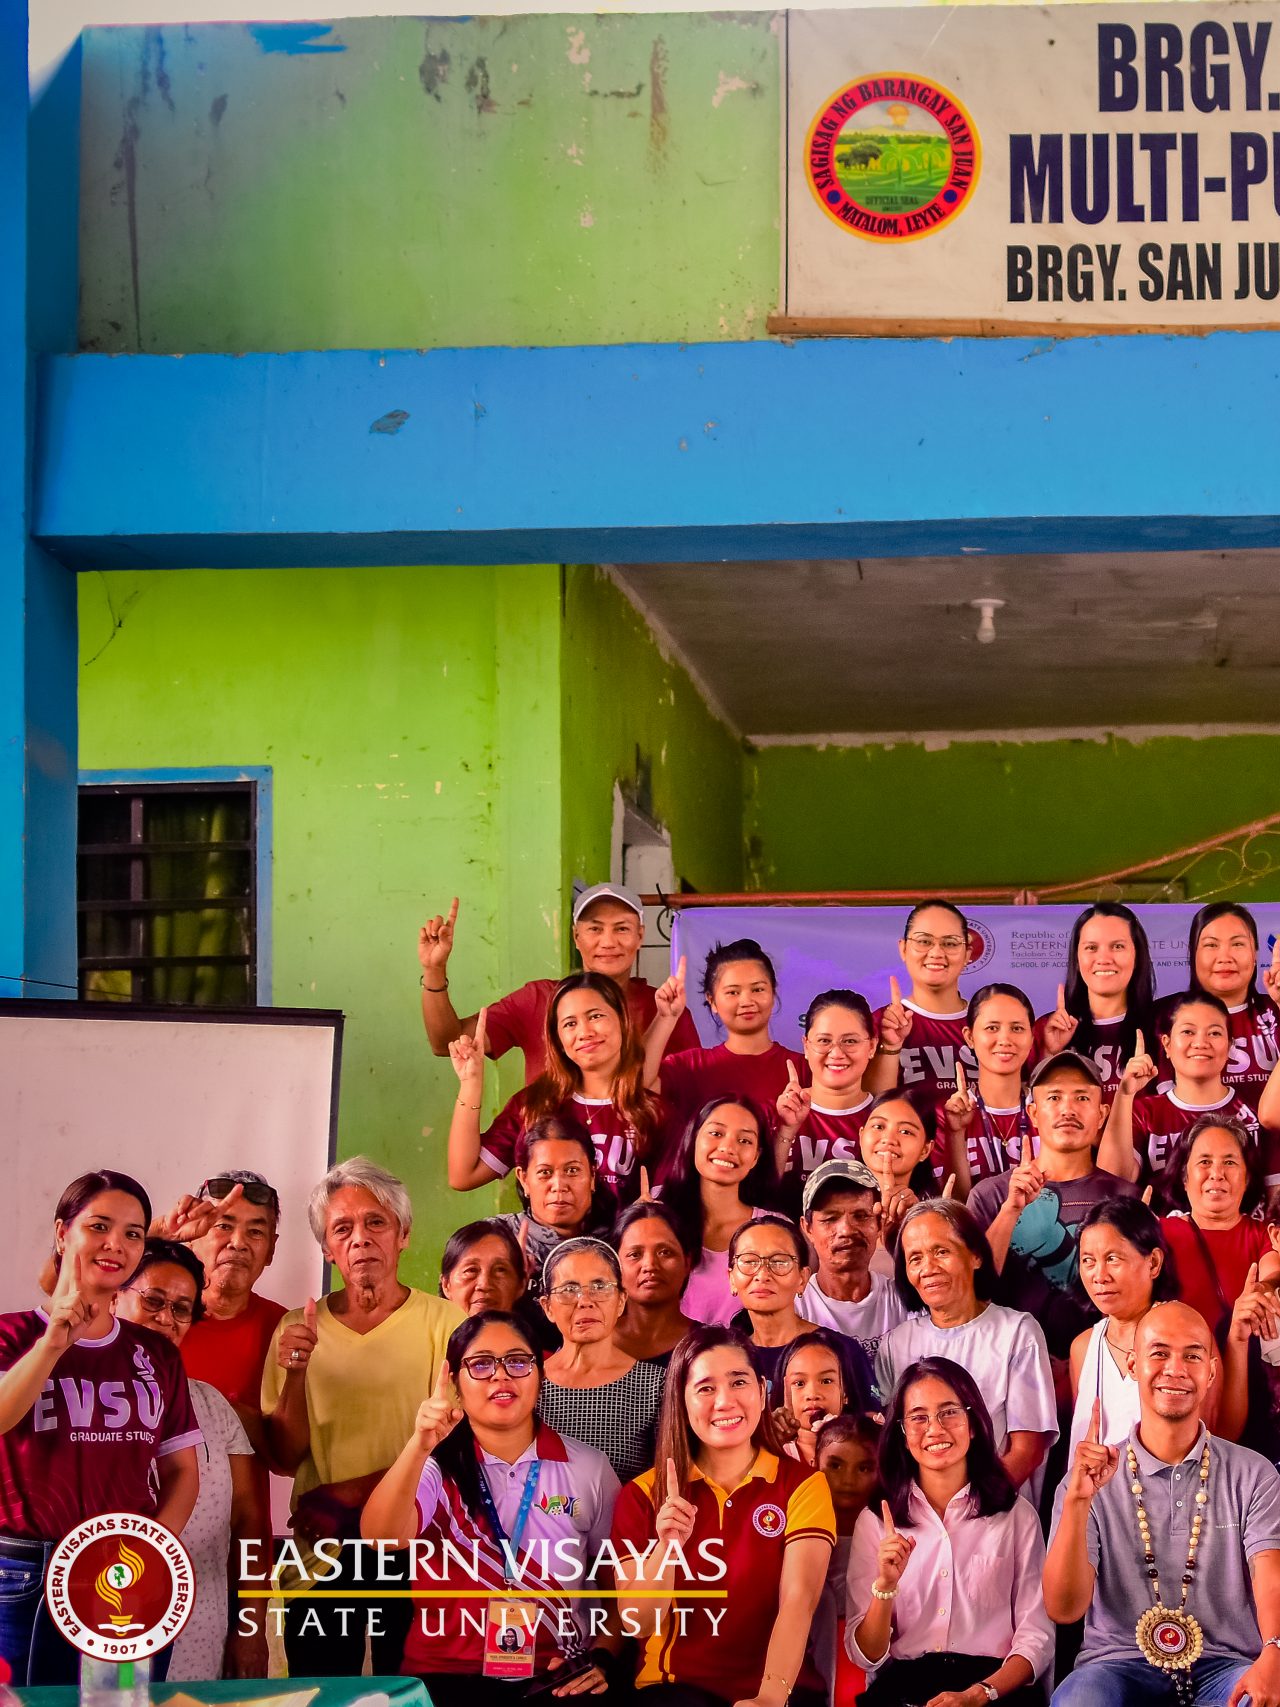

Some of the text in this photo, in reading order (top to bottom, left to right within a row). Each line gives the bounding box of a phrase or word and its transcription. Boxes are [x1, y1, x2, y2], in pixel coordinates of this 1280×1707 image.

[1097, 20, 1280, 113] BRGY.
[811, 79, 974, 191] SAGISAG NG BARANGAY SAN JUAN
[837, 202, 946, 237] MATALOM, LEYTE
[1006, 243, 1127, 302] BRGY.
[1139, 242, 1222, 301] SAN
[1011, 930, 1070, 940] Republic of
[1011, 941, 1067, 950] EASTERN
[1226, 1034, 1280, 1074] SU
[33, 1377, 165, 1433] EVSU
[70, 1431, 123, 1442] GRADUATE
